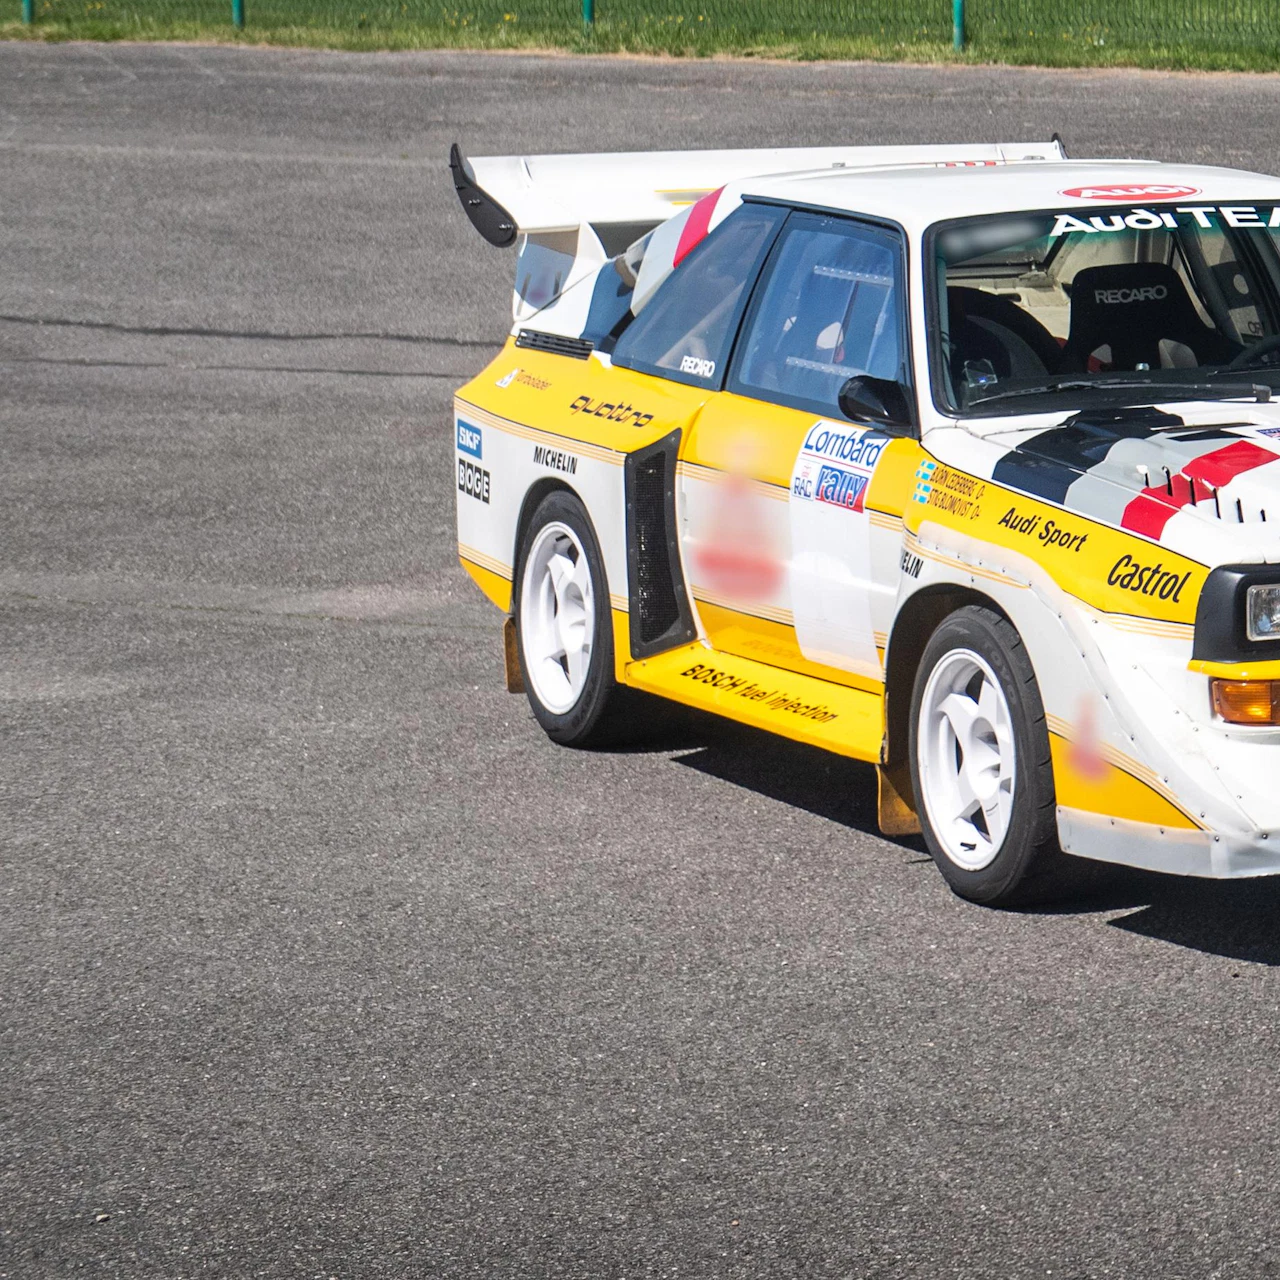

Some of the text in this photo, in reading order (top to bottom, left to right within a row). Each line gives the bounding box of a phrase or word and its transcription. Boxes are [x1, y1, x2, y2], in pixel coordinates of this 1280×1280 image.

[1080, 184, 1192, 199] Audi
[1050, 209, 1178, 237] Audi
[1095, 284, 1168, 304] RECARO
[680, 355, 715, 378] RECARO
[569, 395, 655, 428] quattro
[459, 426, 481, 451] SKF
[804, 422, 890, 467] Lombard
[533, 446, 578, 475] MICHELIN
[459, 463, 490, 502] BOGE
[793, 477, 813, 499] RAC
[815, 466, 868, 507] rally
[998, 507, 1088, 552] Audi Sport
[1107, 554, 1192, 603] Castrol
[680, 664, 840, 724] BOSCH fuel injection
